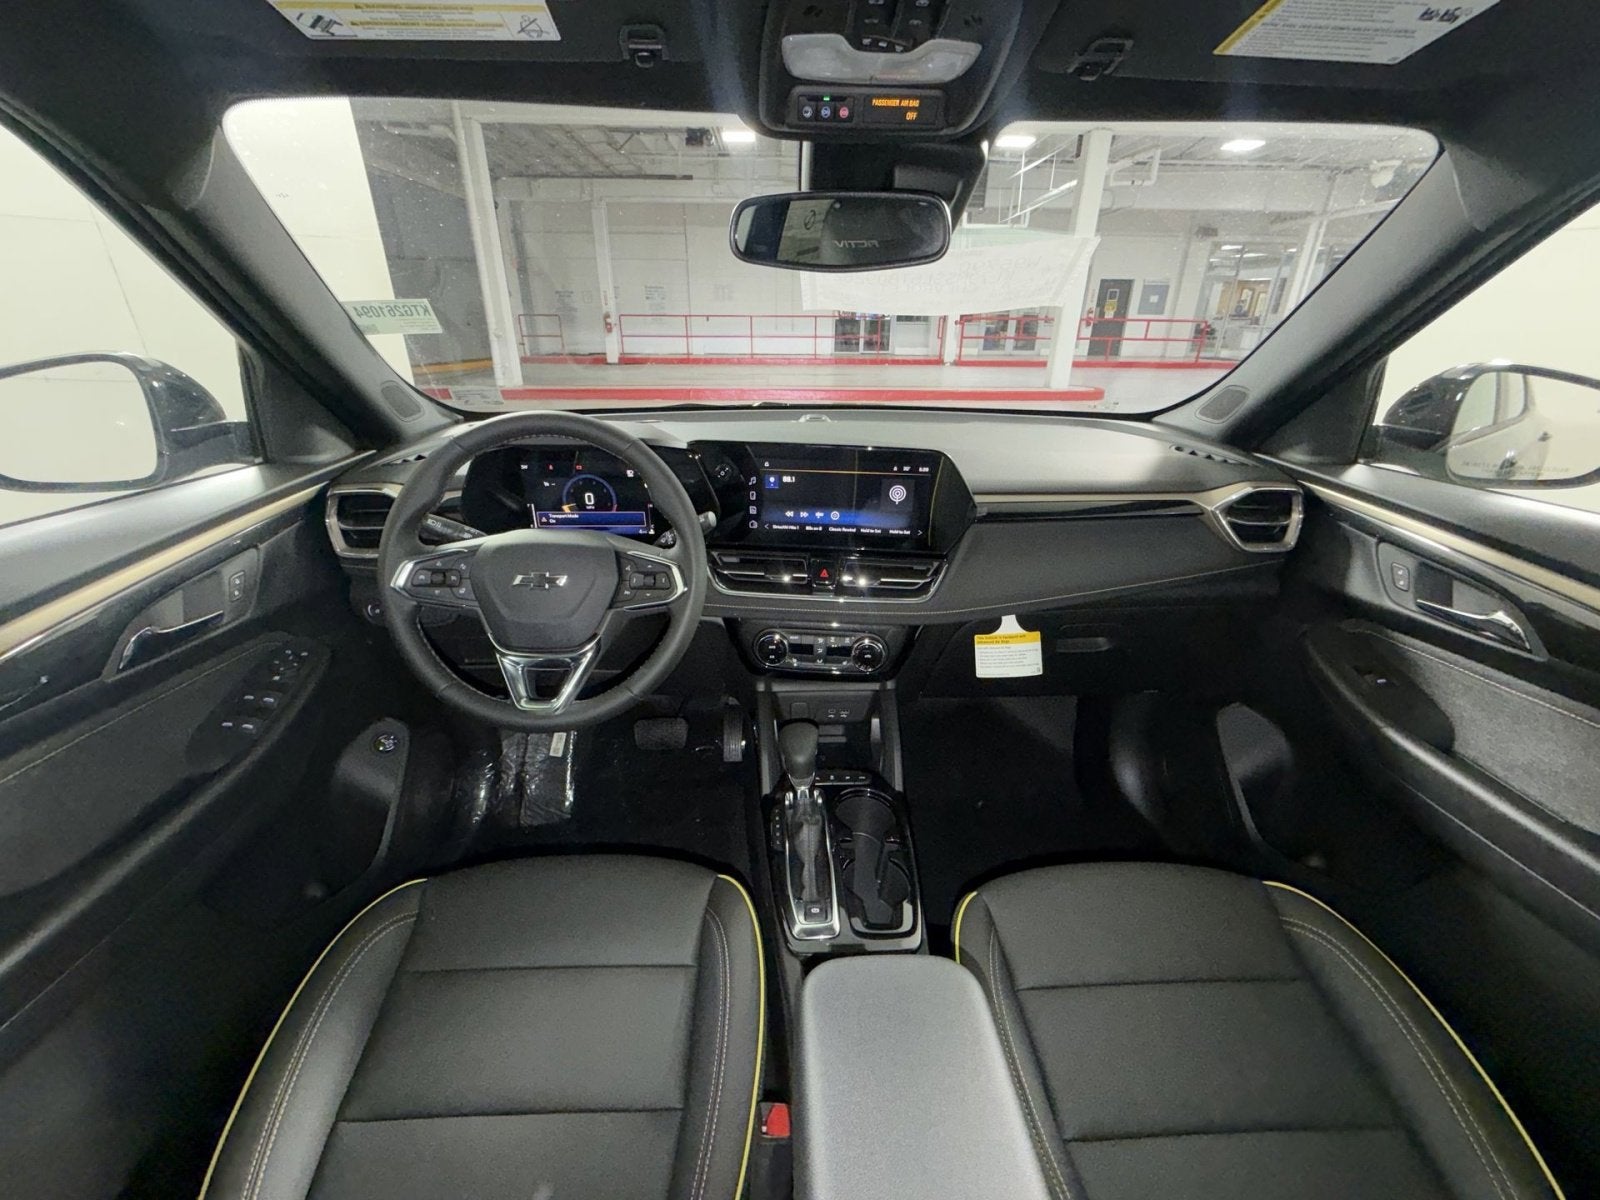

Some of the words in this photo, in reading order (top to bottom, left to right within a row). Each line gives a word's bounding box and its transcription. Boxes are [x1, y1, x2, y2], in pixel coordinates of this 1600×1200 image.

[872, 99, 900, 107] PASSENGER
[900, 99, 909, 107] AIR
[909, 99, 919, 107] BAG
[905, 111, 918, 120] OFF
[584, 492, 595, 505] 0
